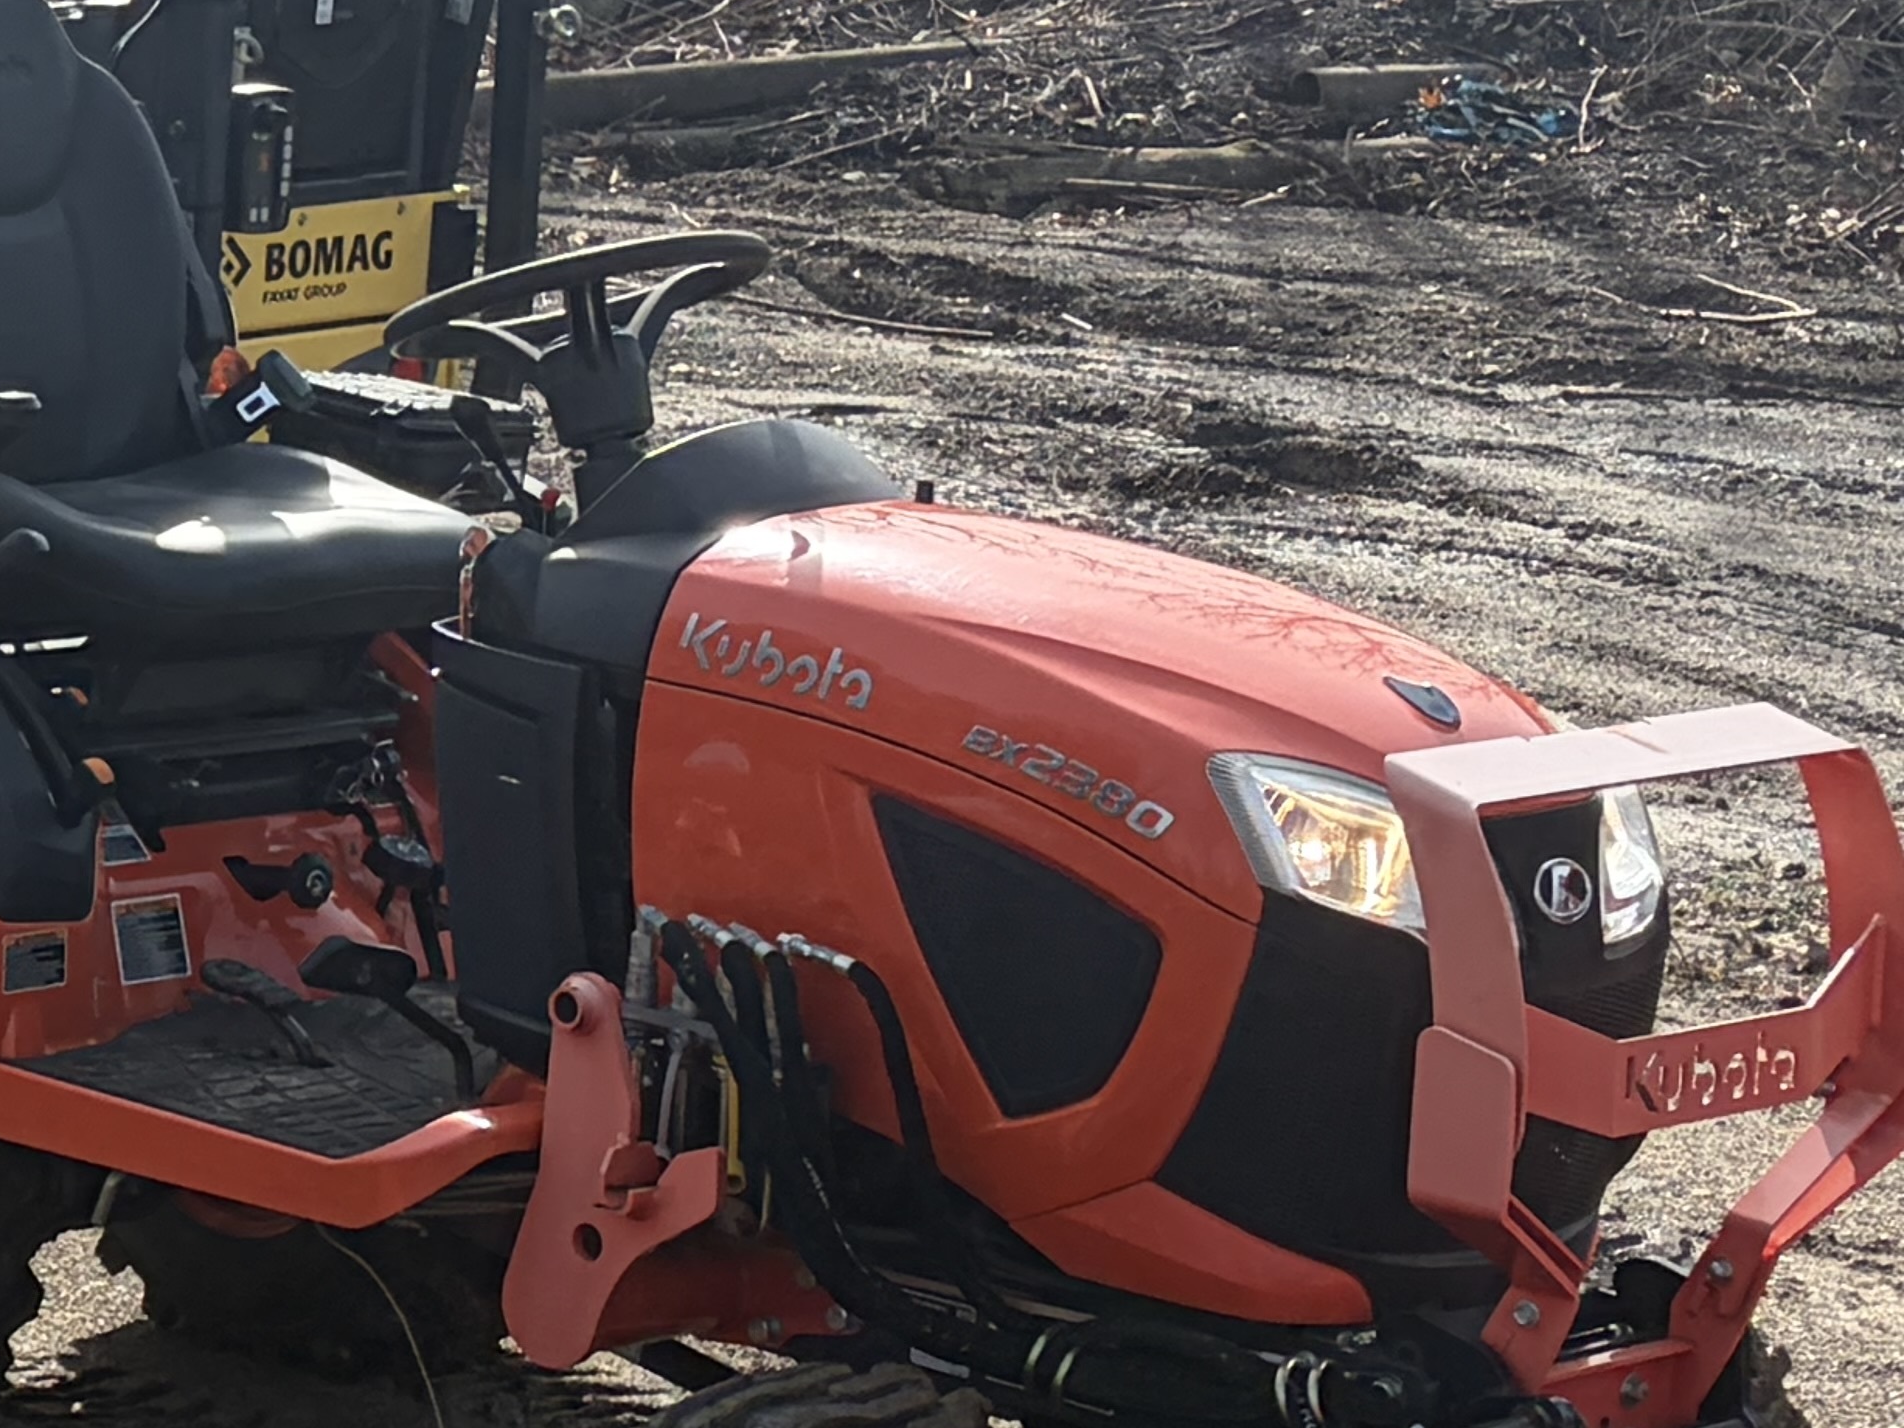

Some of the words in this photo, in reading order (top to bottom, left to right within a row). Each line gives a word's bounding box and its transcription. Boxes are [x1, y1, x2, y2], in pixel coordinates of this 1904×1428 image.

[263, 287, 300, 304] FAYAT
[303, 282, 347, 301] GROUP
[265, 231, 393, 282] BOMAG
[679, 612, 874, 710] Kubota
[960, 724, 1176, 839] BX2380
[1623, 1029, 1798, 1113] Kubota
